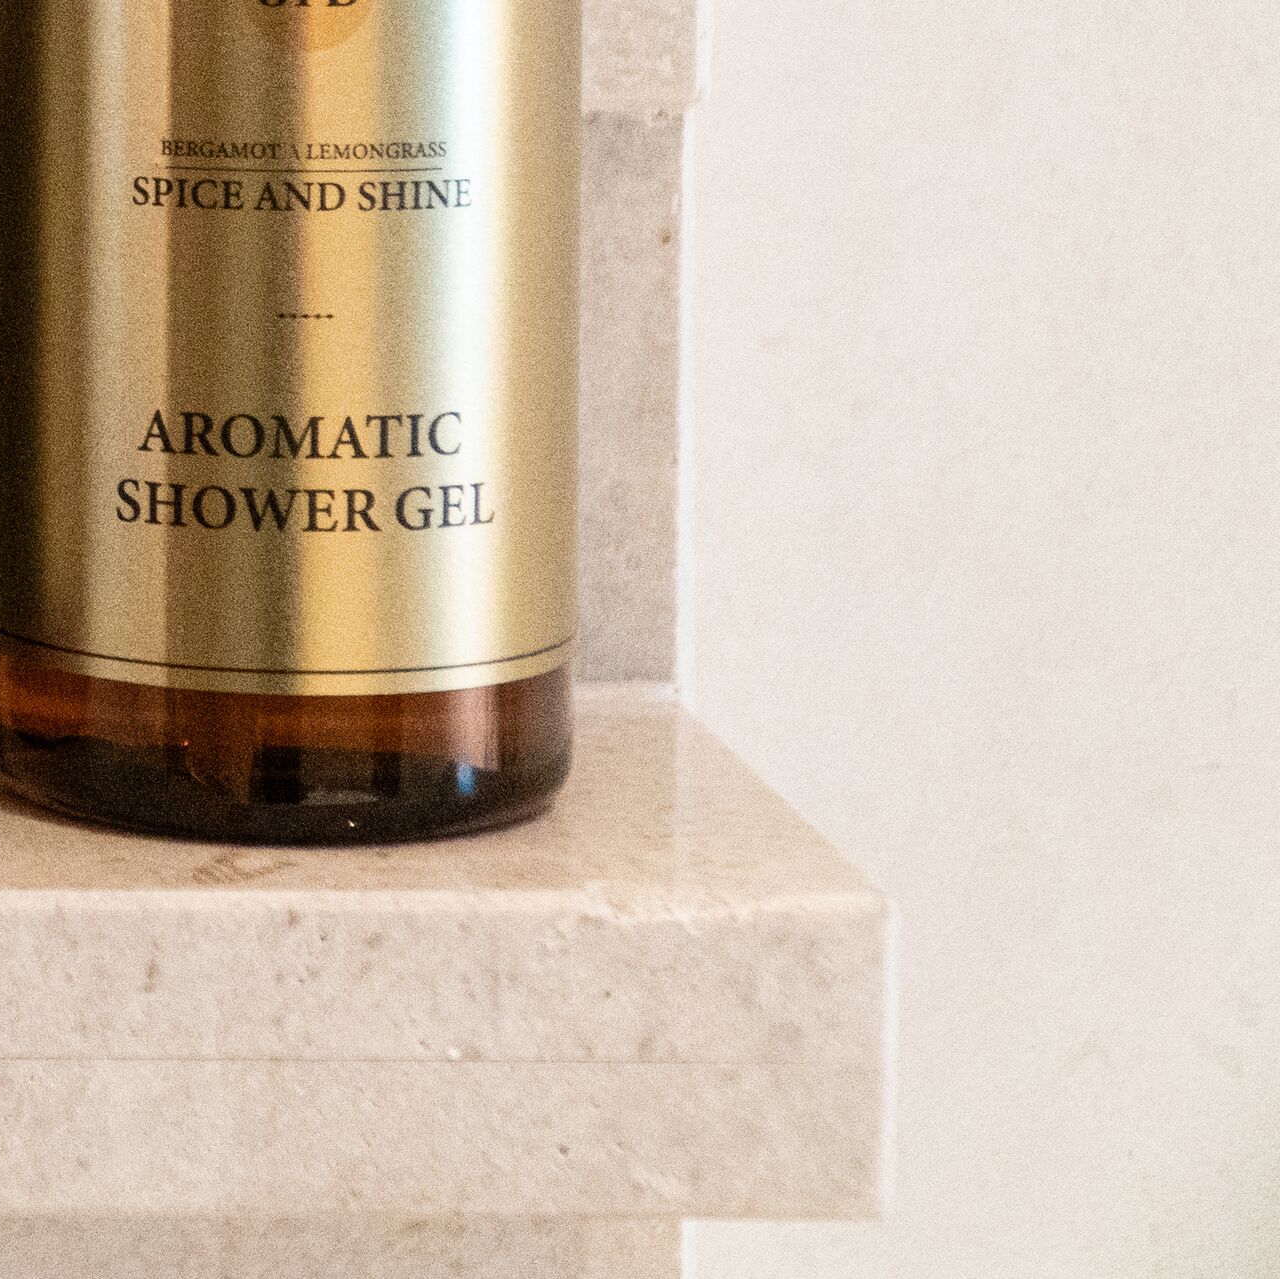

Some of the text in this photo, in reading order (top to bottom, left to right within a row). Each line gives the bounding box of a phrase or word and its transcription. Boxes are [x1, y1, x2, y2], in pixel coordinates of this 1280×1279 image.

[161, 140, 279, 160] BERGAMOT
[305, 140, 447, 161] LEMONGRASS
[132, 176, 472, 212] SPICE AND SHINE
[138, 410, 462, 460] AROMATIC
[116, 479, 494, 534] SHOWER GEL
